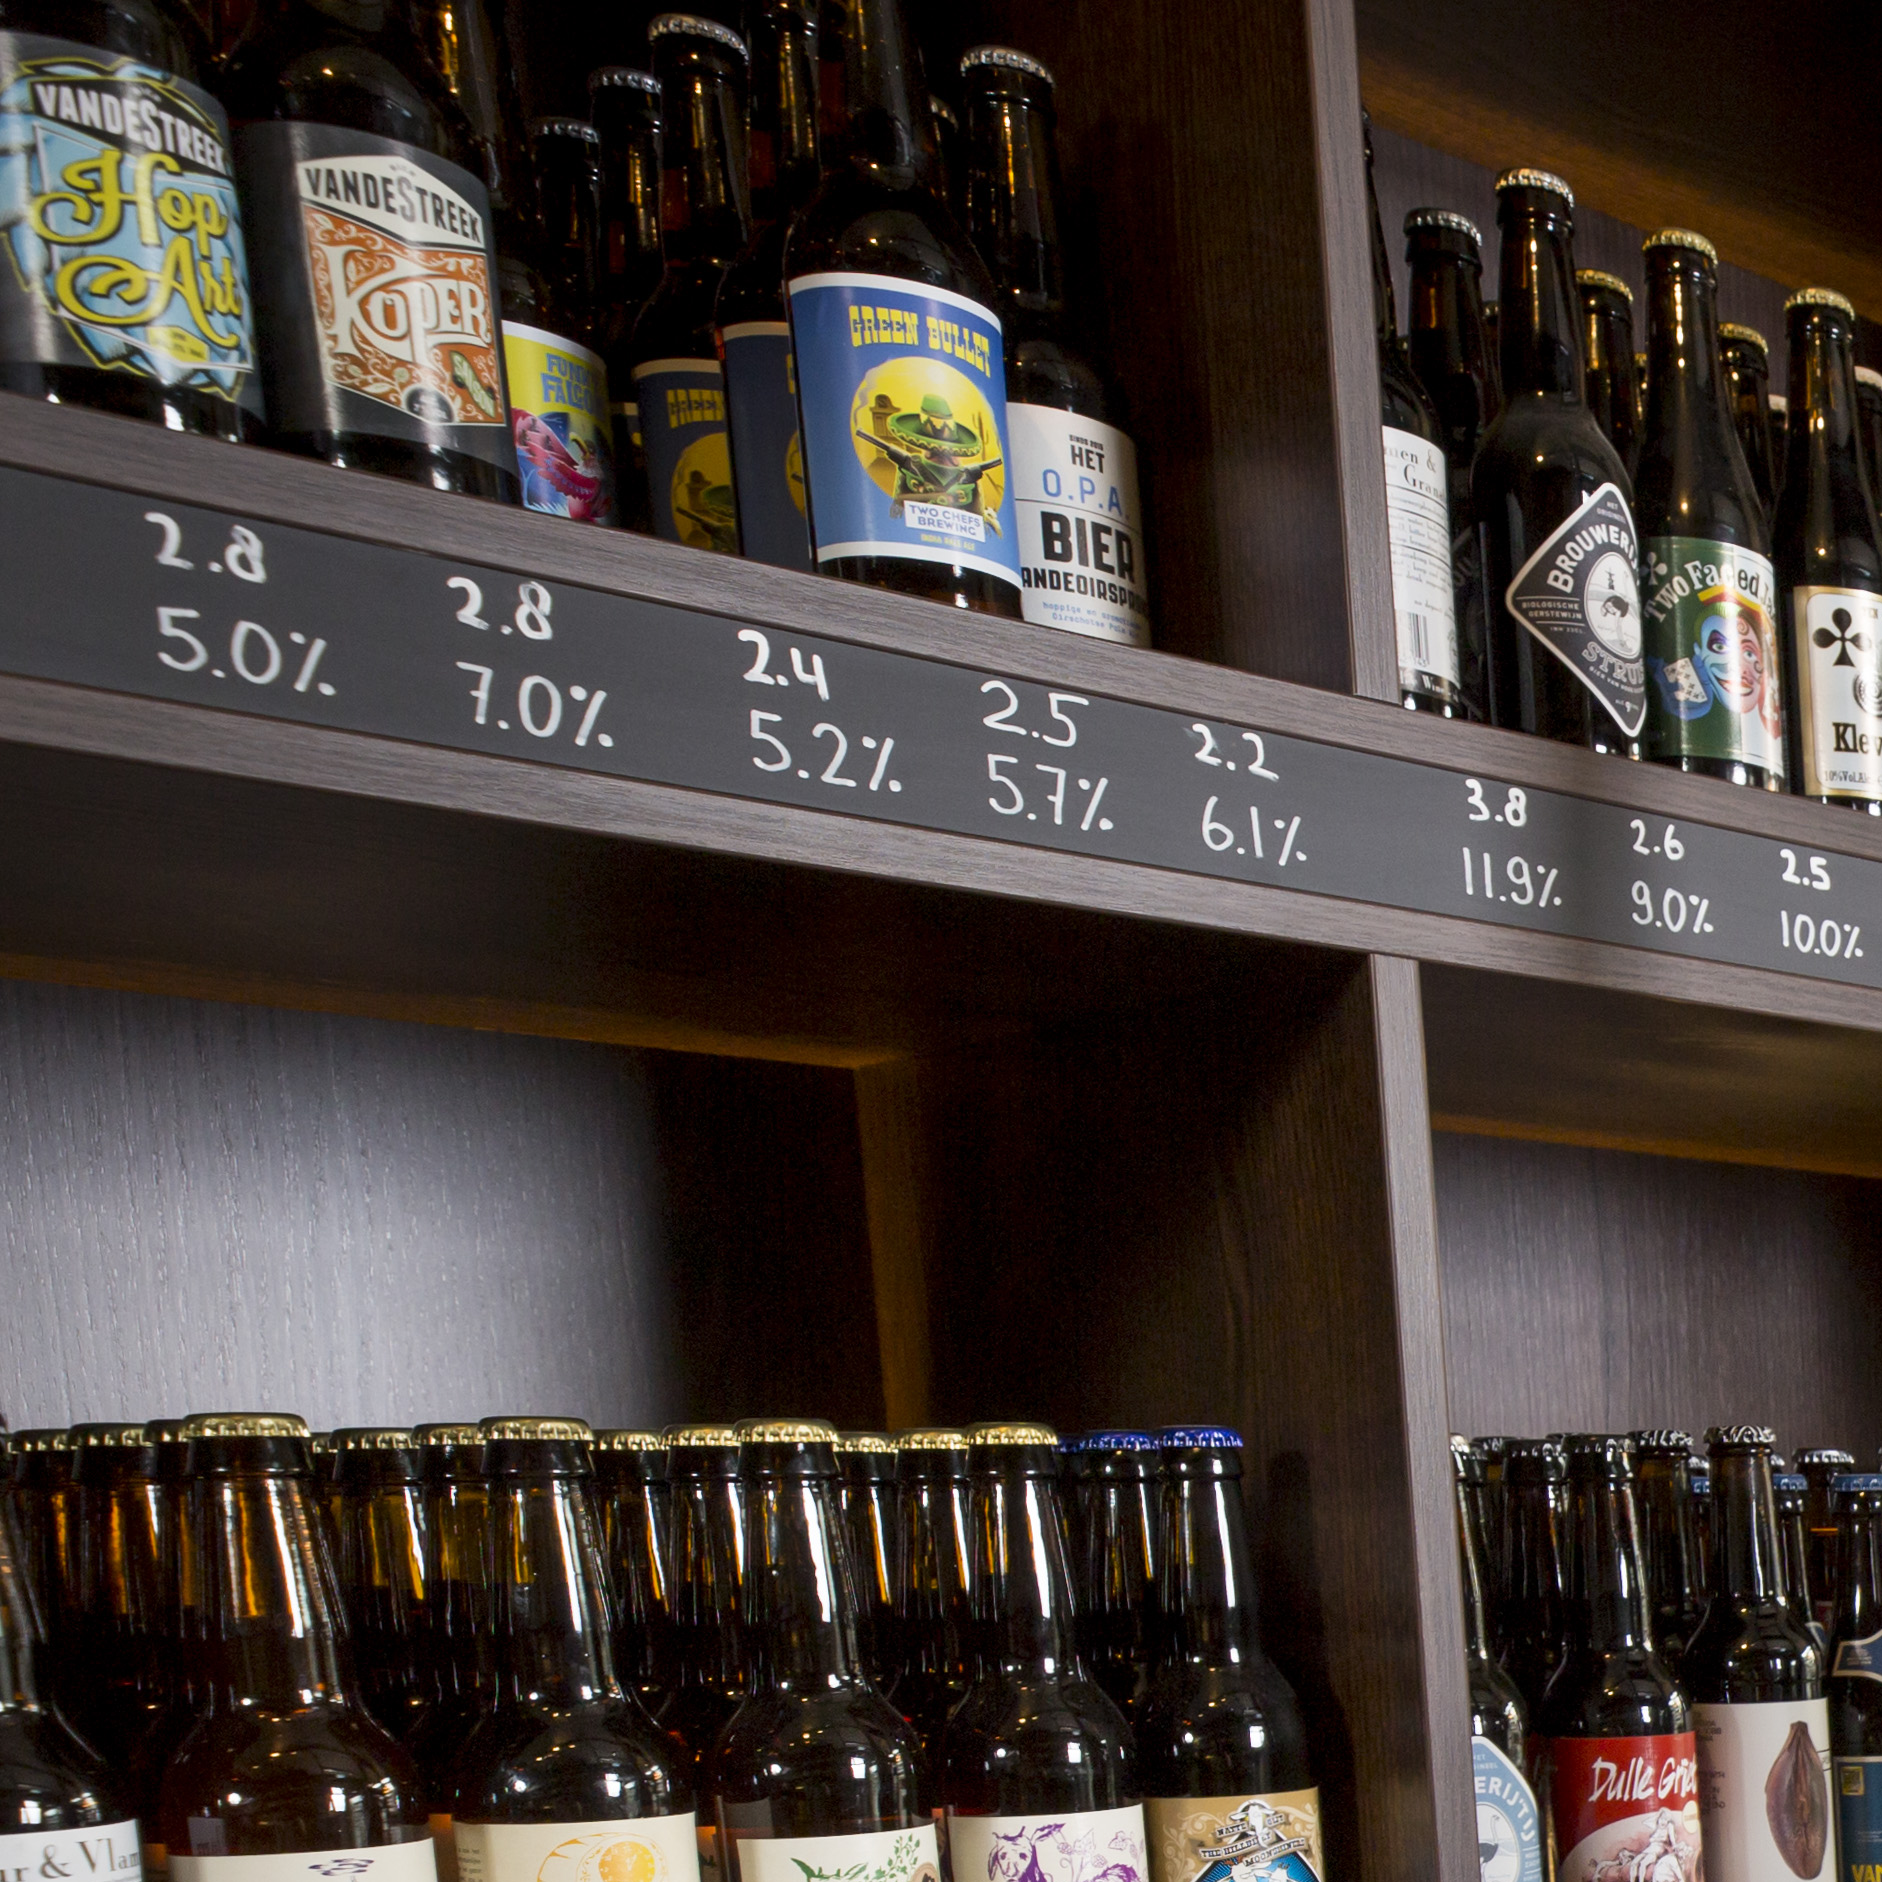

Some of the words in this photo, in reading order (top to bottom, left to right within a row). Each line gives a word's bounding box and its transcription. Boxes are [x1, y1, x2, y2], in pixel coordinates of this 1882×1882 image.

[36, 83, 226, 172] VANDESTREEK
[31, 149, 228, 257] Hop
[305, 167, 482, 243] VANDESTREEK
[55, 235, 243, 348] Art
[849, 305, 919, 347] GREEN
[926, 315, 991, 378] BULLET
[1071, 445, 1105, 474] HET
[144, 512, 267, 584] 2.8
[909, 504, 939, 523] TWO
[942, 509, 981, 530] CHEFS
[917, 515, 979, 537] BREWING
[1040, 511, 1135, 585] BIER
[446, 576, 553, 640] 2.8
[157, 606, 336, 696] 5.0%
[737, 629, 830, 701] 2.4
[456, 661, 614, 748] 7.0%
[980, 680, 1090, 748] 2.5
[750, 709, 902, 793] 5.2%
[1191, 723, 1280, 781] 2.2
[987, 753, 1114, 831] 5.7%
[1465, 778, 1527, 827] 3.8
[1201, 795, 1307, 867] 6.1%
[1630, 819, 1685, 861] 2.6
[1462, 846, 1562, 908] 11.9%
[1779, 848, 1831, 891] 2.5
[1631, 880, 1714, 934] 9.0%
[1780, 910, 1864, 959] 10.0%
[1588, 1756, 1655, 1802] Dulle
